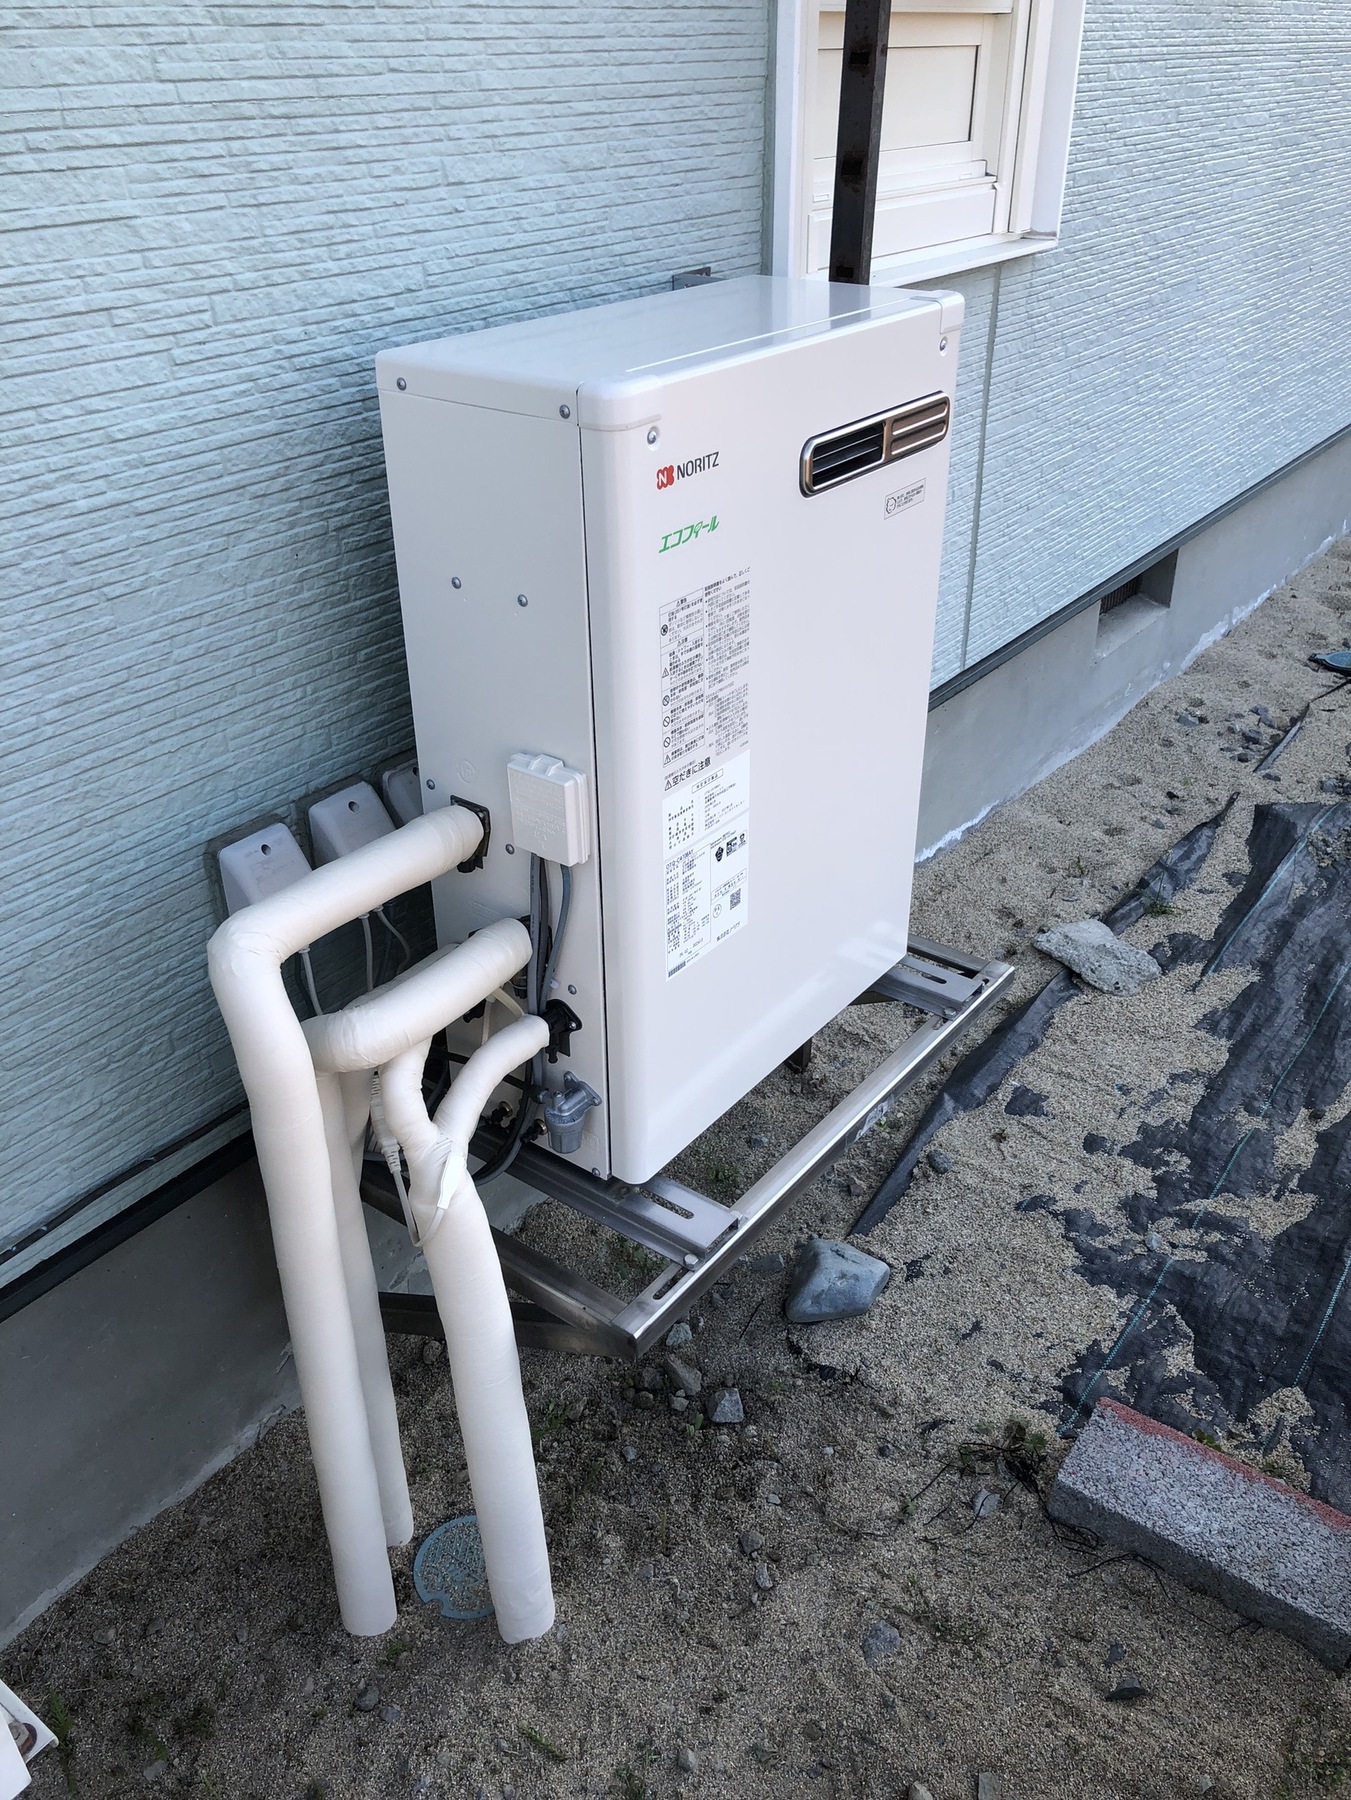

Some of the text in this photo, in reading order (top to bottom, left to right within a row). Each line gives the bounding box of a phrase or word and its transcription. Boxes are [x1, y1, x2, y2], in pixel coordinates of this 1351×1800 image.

[677, 451, 719, 480] NORITZ
[658, 515, 720, 553] エコフィール
[672, 756, 711, 787] 空だきに注意
